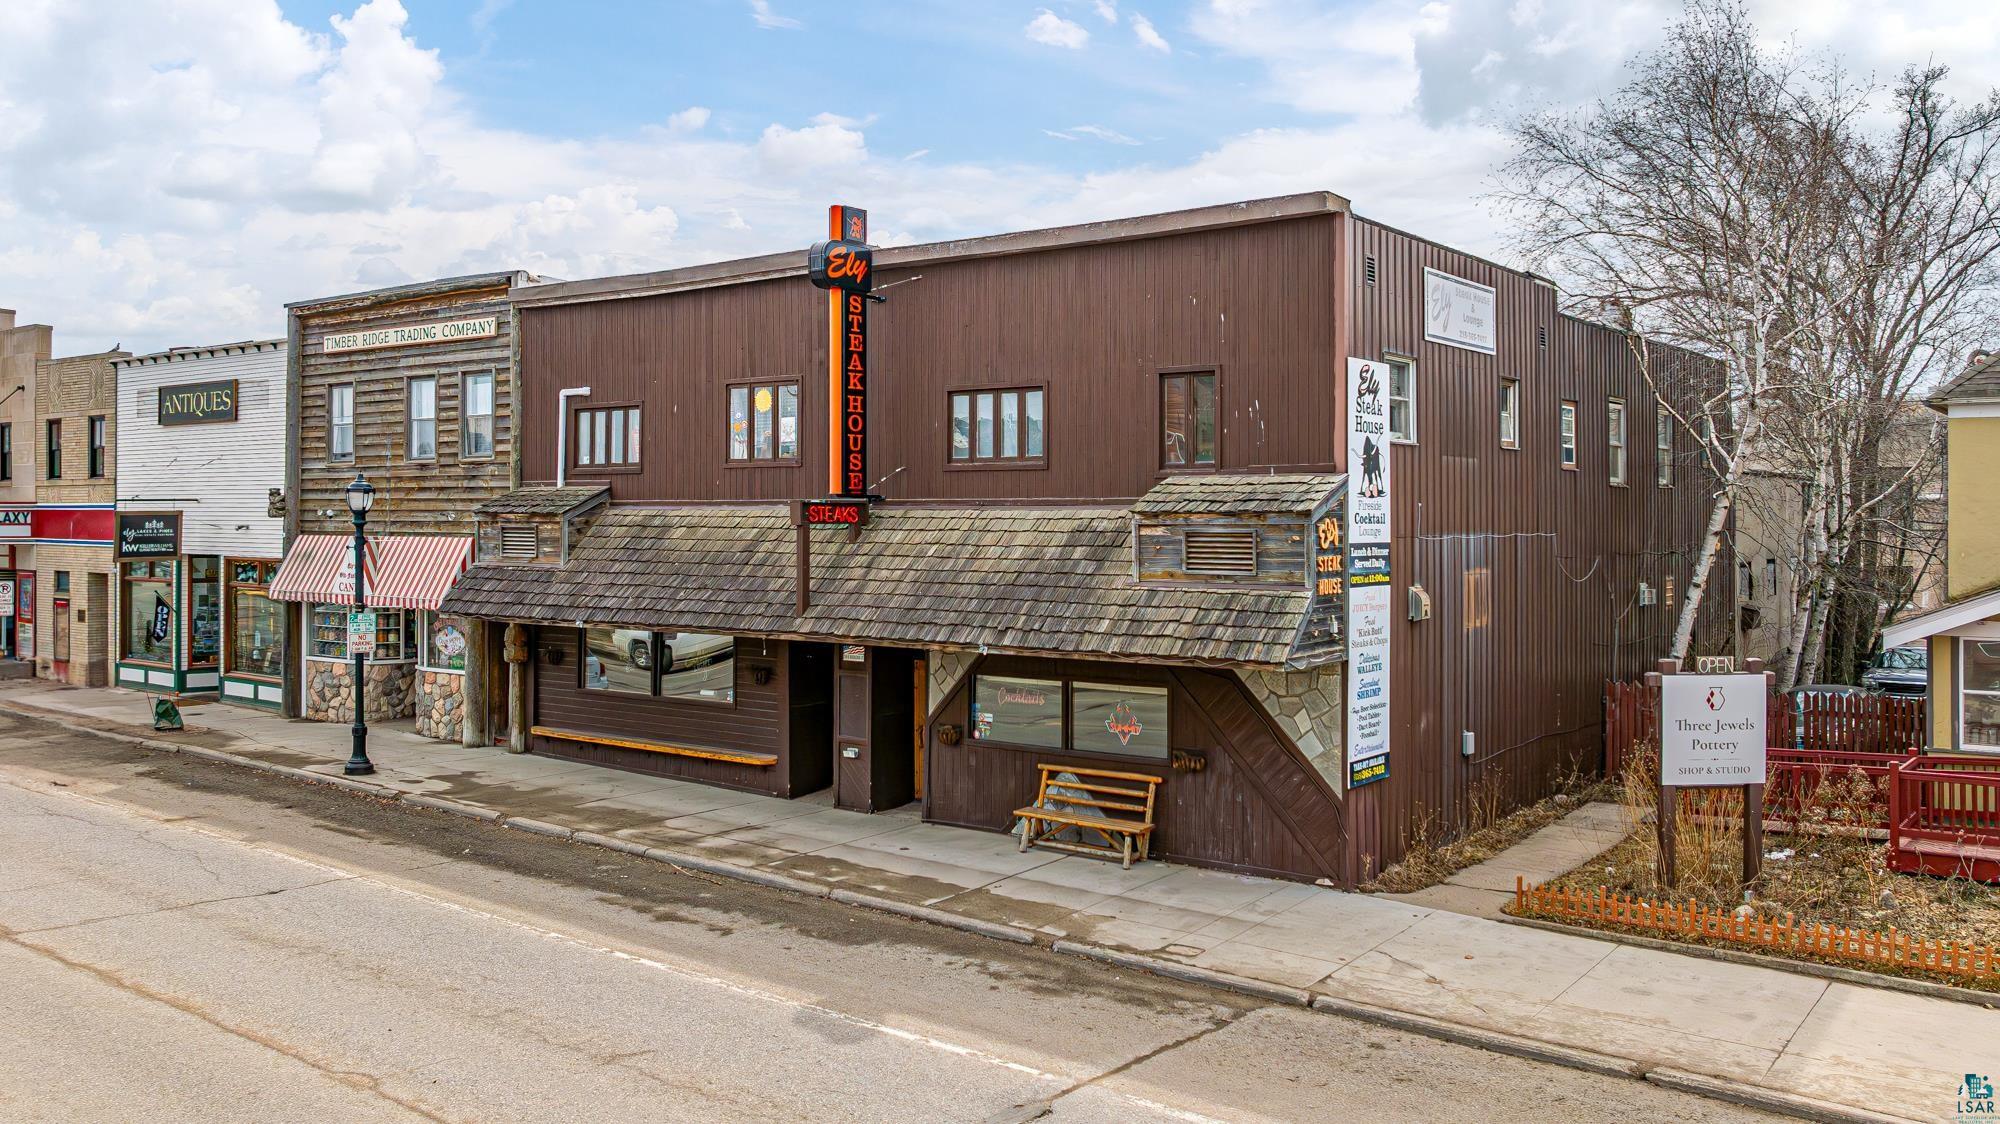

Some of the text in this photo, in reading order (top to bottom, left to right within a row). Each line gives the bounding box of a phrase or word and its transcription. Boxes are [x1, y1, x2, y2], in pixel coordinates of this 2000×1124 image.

[828, 246, 867, 283] Ely
[1431, 283, 1452, 333] Ely
[325, 320, 494, 350] TIMBER RIDGE TRADING COMPANY
[1357, 364, 1380, 403] Ely
[163, 390, 231, 416] ANTIQUES
[1355, 398, 1383, 416] Steak
[1355, 415, 1383, 435] House
[809, 505, 858, 522] STEAKS
[1358, 500, 1383, 511] Fireside
[1355, 513, 1386, 524] Cocktail
[1359, 526, 1381, 538] Lounge
[1351, 547, 1389, 556] Lunch & Dinner
[1317, 555, 1342, 572] STEAK
[1354, 558, 1386, 569] Served Daily
[1318, 578, 1342, 596] HOUSE
[155, 605, 169, 637] OPEN
[1351, 638, 1368, 648] Steaks
[1357, 663, 1382, 675] WALLEYE
[1698, 657, 1734, 673] OPEN
[998, 687, 1045, 706] Cocktails
[1357, 687, 1381, 700] SHRIMP
[1675, 718, 1755, 734] Three Jewels
[1692, 738, 1739, 753] Pottery
[1678, 766, 1751, 775] SHOP & STUDIO
